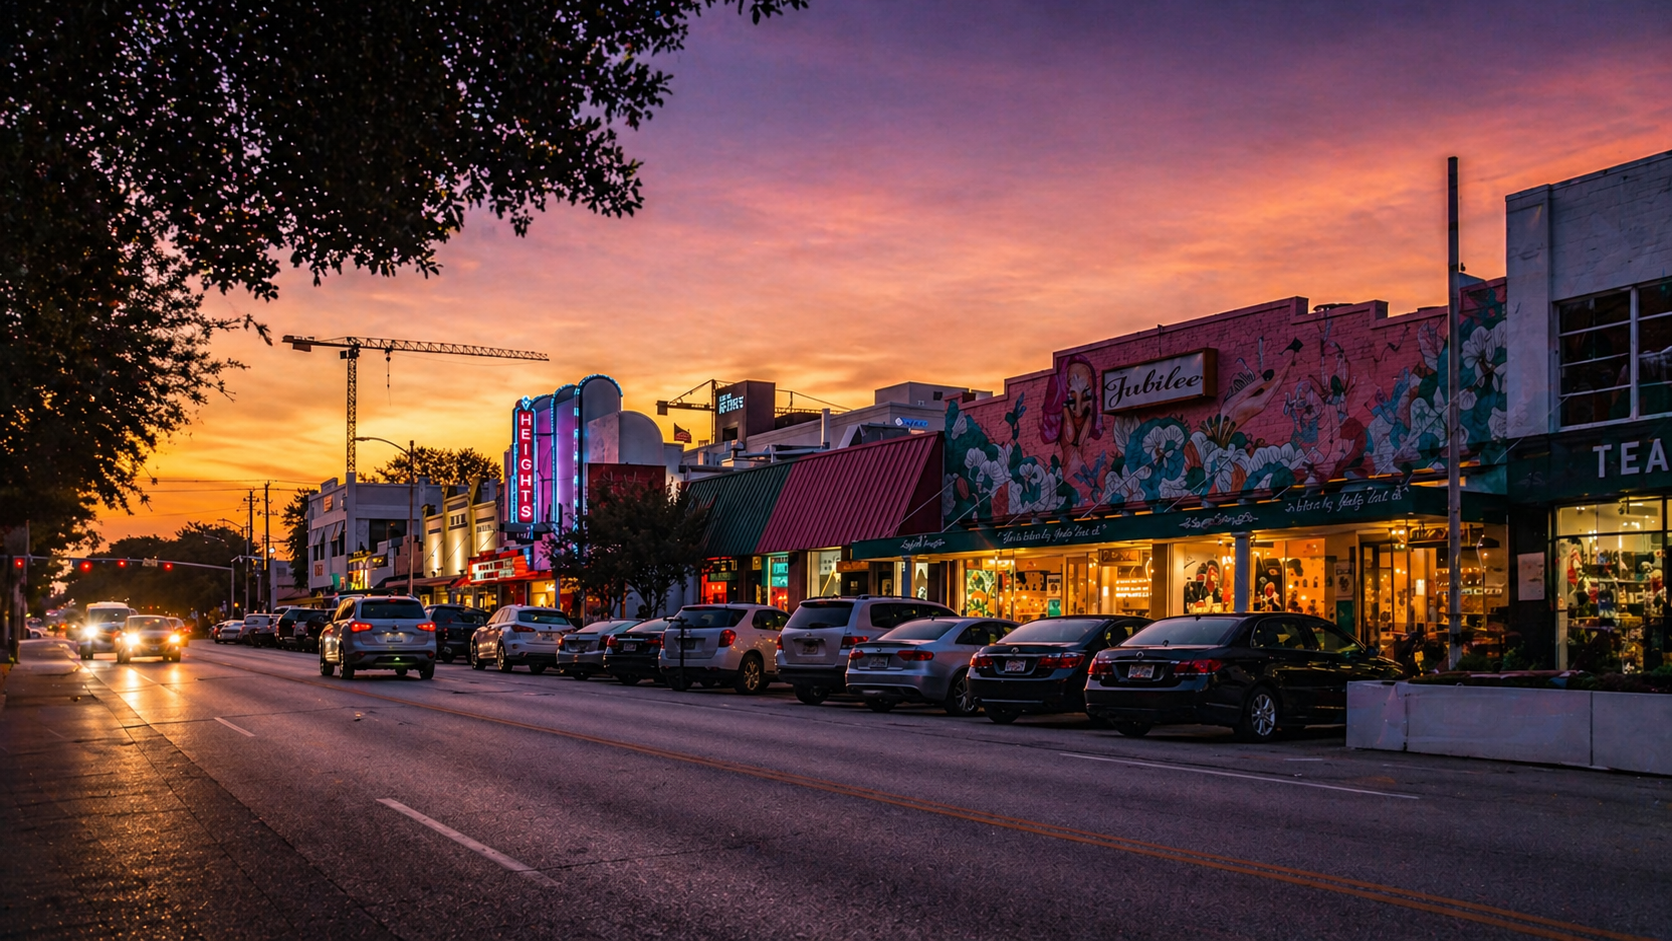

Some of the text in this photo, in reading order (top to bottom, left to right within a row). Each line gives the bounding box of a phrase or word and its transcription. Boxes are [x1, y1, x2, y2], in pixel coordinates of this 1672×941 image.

[1104, 365, 1203, 409] Jubilee
[520, 414, 532, 518] HEIGHTS
[1592, 437, 1670, 478] TEA
